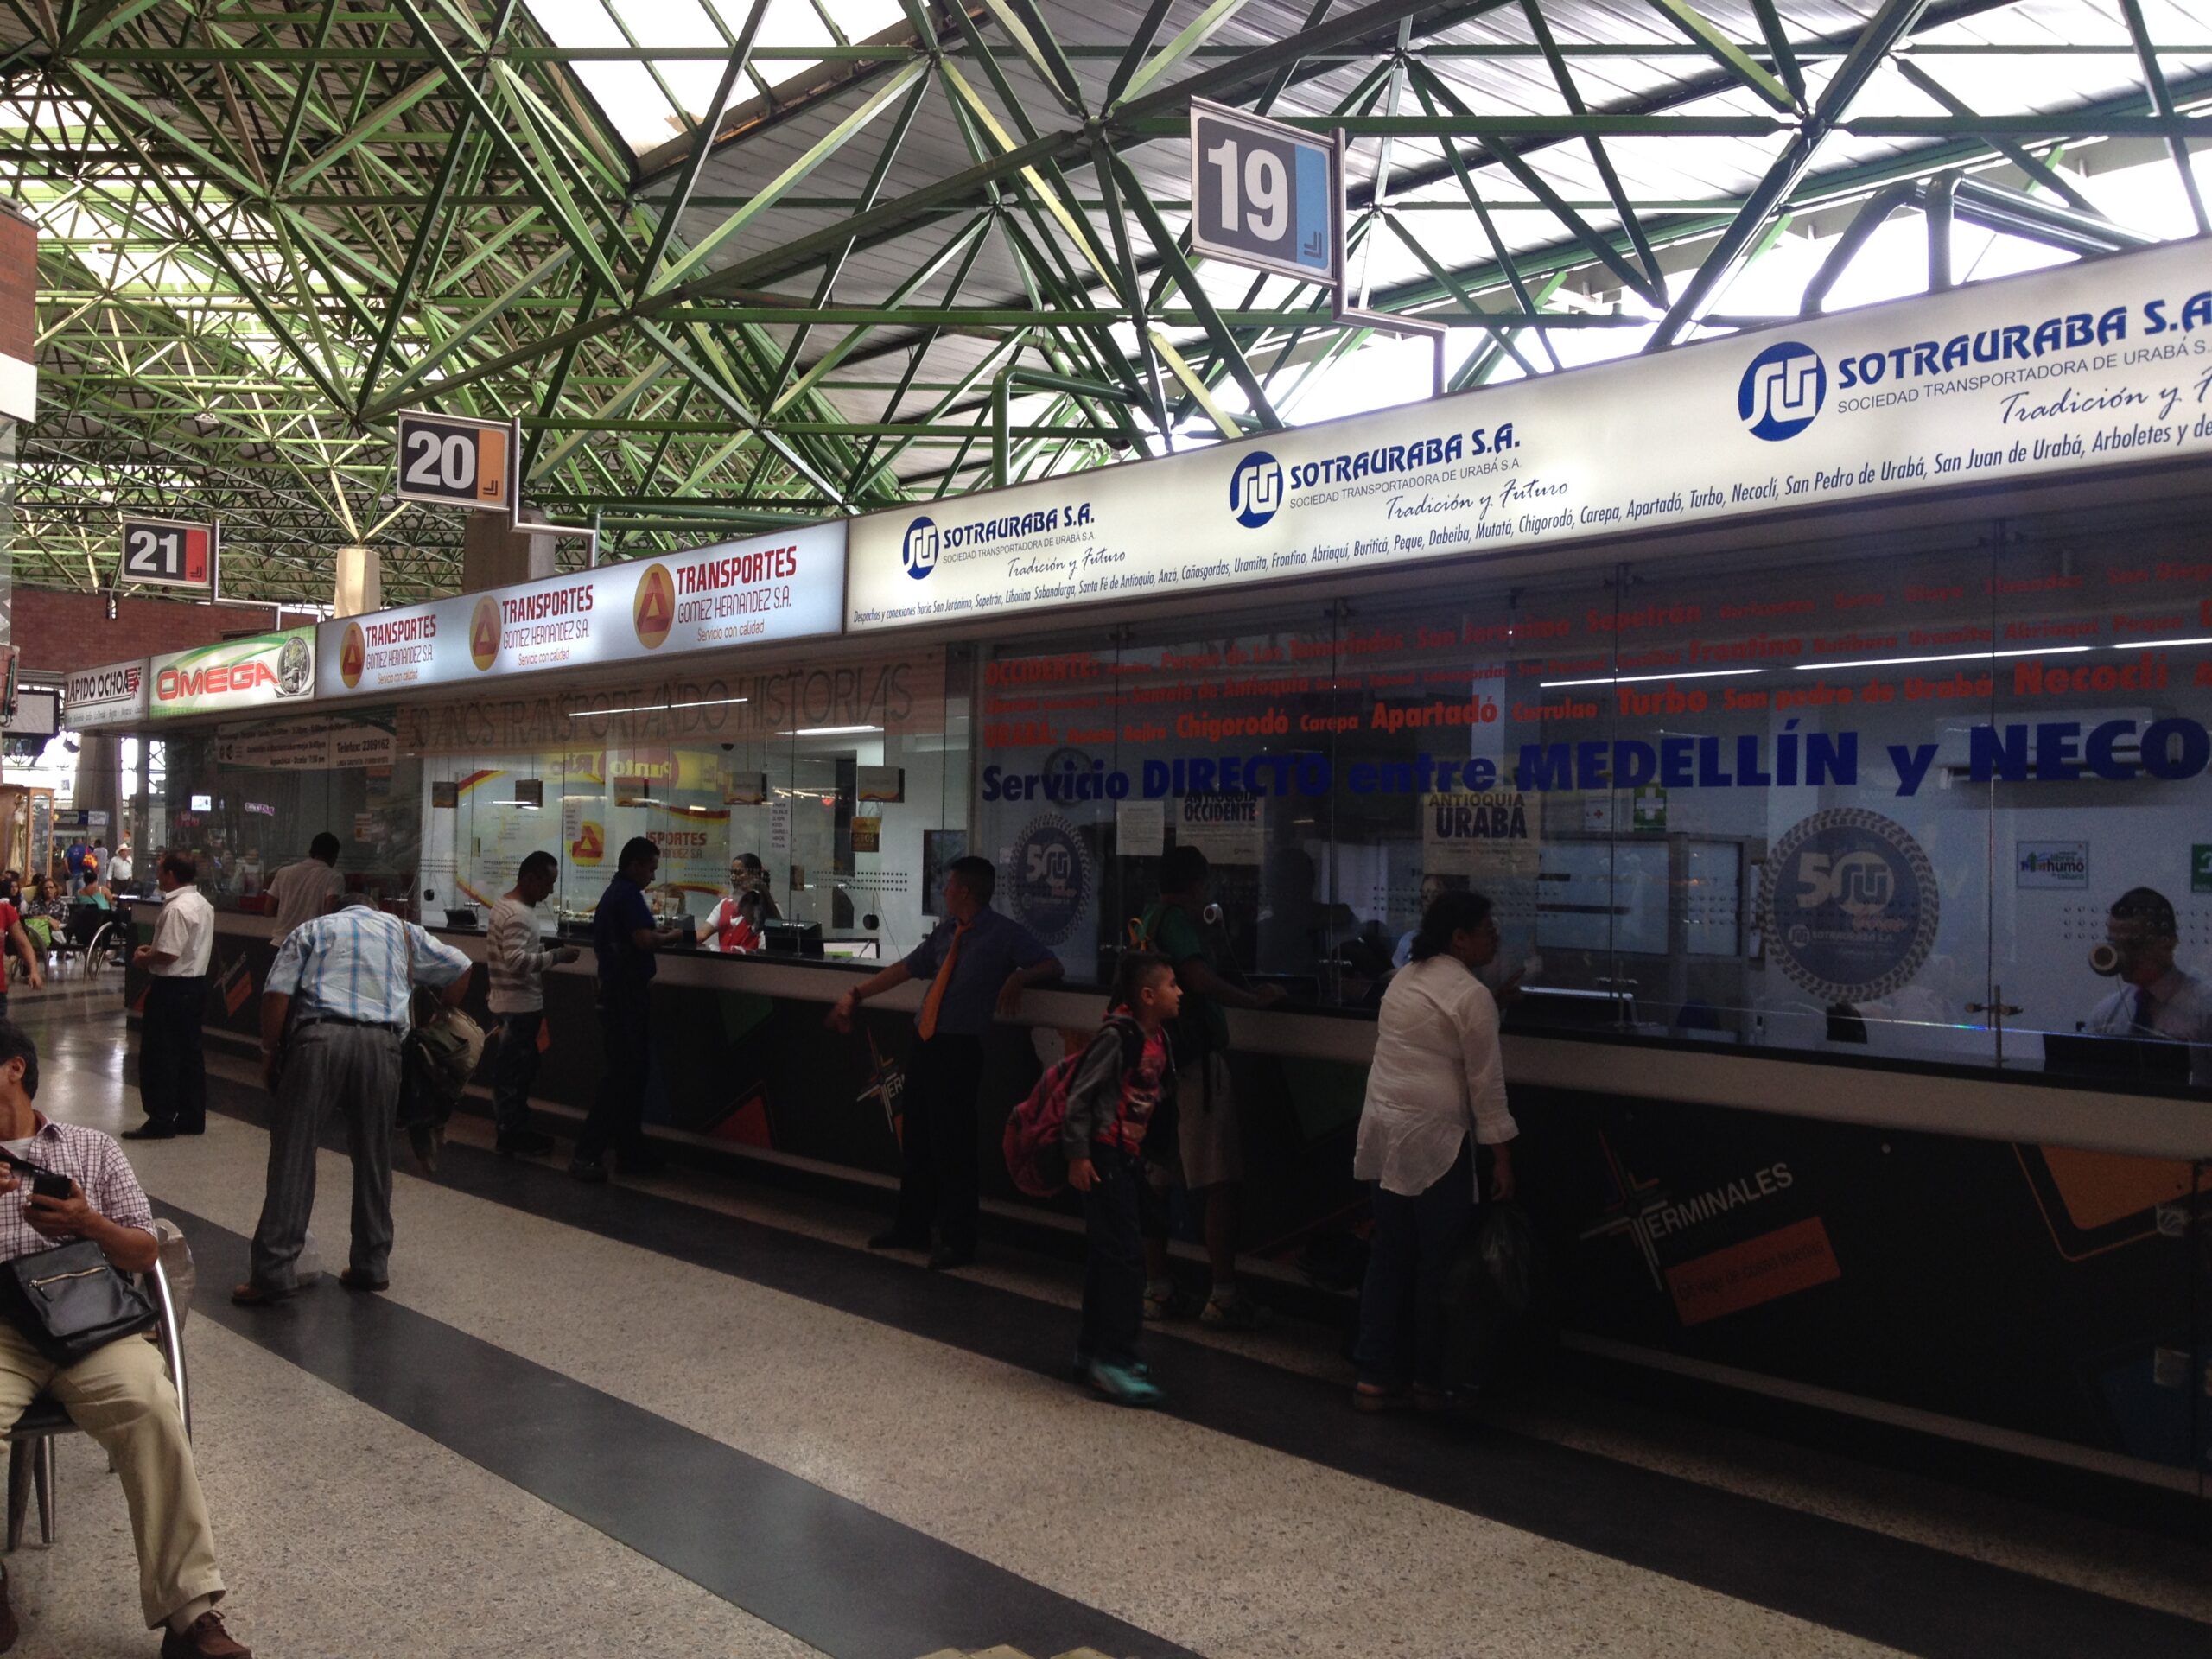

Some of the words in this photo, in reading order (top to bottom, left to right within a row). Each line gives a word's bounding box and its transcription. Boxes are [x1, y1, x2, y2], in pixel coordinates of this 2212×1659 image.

[1208, 138, 1288, 242] 19
[1838, 307, 2127, 389] SOTRAURABA
[1837, 388, 1919, 414] SOCIEDAD
[1923, 359, 2088, 398] TRANSPORTADORA
[2093, 353, 2119, 370] DE
[2123, 335, 2190, 366] URABÁ
[2000, 388, 2149, 424] Tradición
[2159, 387, 2183, 420] y
[406, 430, 475, 489] 20
[1290, 433, 1463, 490] SOTRAURABA
[1472, 422, 1521, 456] S.A.
[1290, 493, 1339, 510] SOCIEDAD
[1341, 474, 1440, 500] TRANSPORTADORA
[1441, 470, 1457, 483] DE
[1460, 456, 1498, 480] URABÁ
[1386, 494, 1473, 520] Tradición
[1479, 494, 1493, 520] y
[1499, 479, 1568, 509] Futuro
[932, 601, 944, 613] San
[1079, 579, 1098, 594] Santa
[1100, 575, 1109, 591] Fé
[1109, 574, 1119, 590] de
[1120, 570, 1156, 588] Antioquia,
[1158, 567, 1179, 585] Anzá,
[1182, 561, 1231, 582] Cañasgordas,
[1234, 556, 1268, 575] Uramita,
[1271, 550, 1307, 568] Frontino,
[1311, 542, 1350, 563] Abriaquí,
[1354, 537, 1390, 557] Buriticá,
[1394, 533, 1425, 555] Peque,
[1429, 524, 1471, 547] Dabeiba,
[1475, 518, 1514, 541] Mutatá,
[1519, 508, 1575, 536] Chigorodó,
[1580, 505, 1621, 527] Carepa,
[1626, 491, 1684, 520] Apartadó,
[1689, 485, 1726, 509] Turbo,
[1732, 476, 1778, 504] Necoclí,
[1785, 475, 1809, 496] San
[1815, 467, 1853, 492] Pedro
[1859, 461, 1875, 485] de
[1880, 454, 1928, 481] Urabá,
[1934, 453, 1961, 474] San
[1966, 441, 2002, 470] Juan
[2008, 440, 2027, 464] de
[2033, 434, 2086, 460] Urabá,
[2091, 423, 2171, 453] Arboletes
[2177, 423, 2189, 446] y
[944, 508, 1058, 549] SOTRAURABA
[1064, 502, 1095, 527] S.A.
[130, 530, 178, 574] 21
[943, 551, 977, 564] SOCIEDAD
[977, 540, 1043, 561] TRANSPORTADORA
[1044, 538, 1054, 548] DE
[1056, 531, 1081, 546] URABÁ
[1008, 558, 1065, 577] Tradición
[1068, 557, 1078, 580] y
[1083, 547, 1126, 570] Futuro
[677, 545, 797, 595] TRANSPORTES
[502, 584, 593, 624] TRANSPORTES
[678, 597, 712, 624] GOMEZ
[715, 588, 771, 620] HERNANDEZ
[773, 585, 791, 608] S.A.
[366, 614, 436, 648] TRANSPORTES
[504, 629, 530, 650] GOMEZ
[531, 620, 574, 647] HERNANDEZ
[576, 618, 589, 639] S.A.
[697, 626, 722, 642] Servicio
[725, 626, 738, 639] con
[740, 619, 765, 636] calidad
[366, 650, 387, 671] GOMEZ
[389, 645, 422, 667] HERNANDEZ
[518, 652, 537, 666] Servicio
[538, 651, 550, 663] con
[550, 646, 569, 662] calidad
[65, 676, 95, 702] RAPIDO
[98, 669, 129, 697] OCHOA
[157, 659, 281, 701] OMEGA
[738, 663, 913, 730] HISTORIAS
[1176, 706, 1289, 743] Chigorodó
[1300, 714, 1359, 734] Carepa
[1371, 694, 1497, 734] Apartadó
[1616, 681, 1708, 716] Turbo
[1723, 687, 1769, 711] San
[1860, 677, 1896, 703] de
[2014, 651, 2168, 695] Necoclí
[982, 759, 1129, 801] Servicio
[1143, 752, 1334, 799] DIRECTO
[1348, 752, 1497, 795] entre
[1516, 719, 1858, 791] MEDELLÍN
[1887, 744, 1940, 797] y
[1969, 718, 2211, 782] NECO
[1185, 803, 1256, 823] OCCIDENTE
[1429, 793, 1525, 807] ANTIOQUIA
